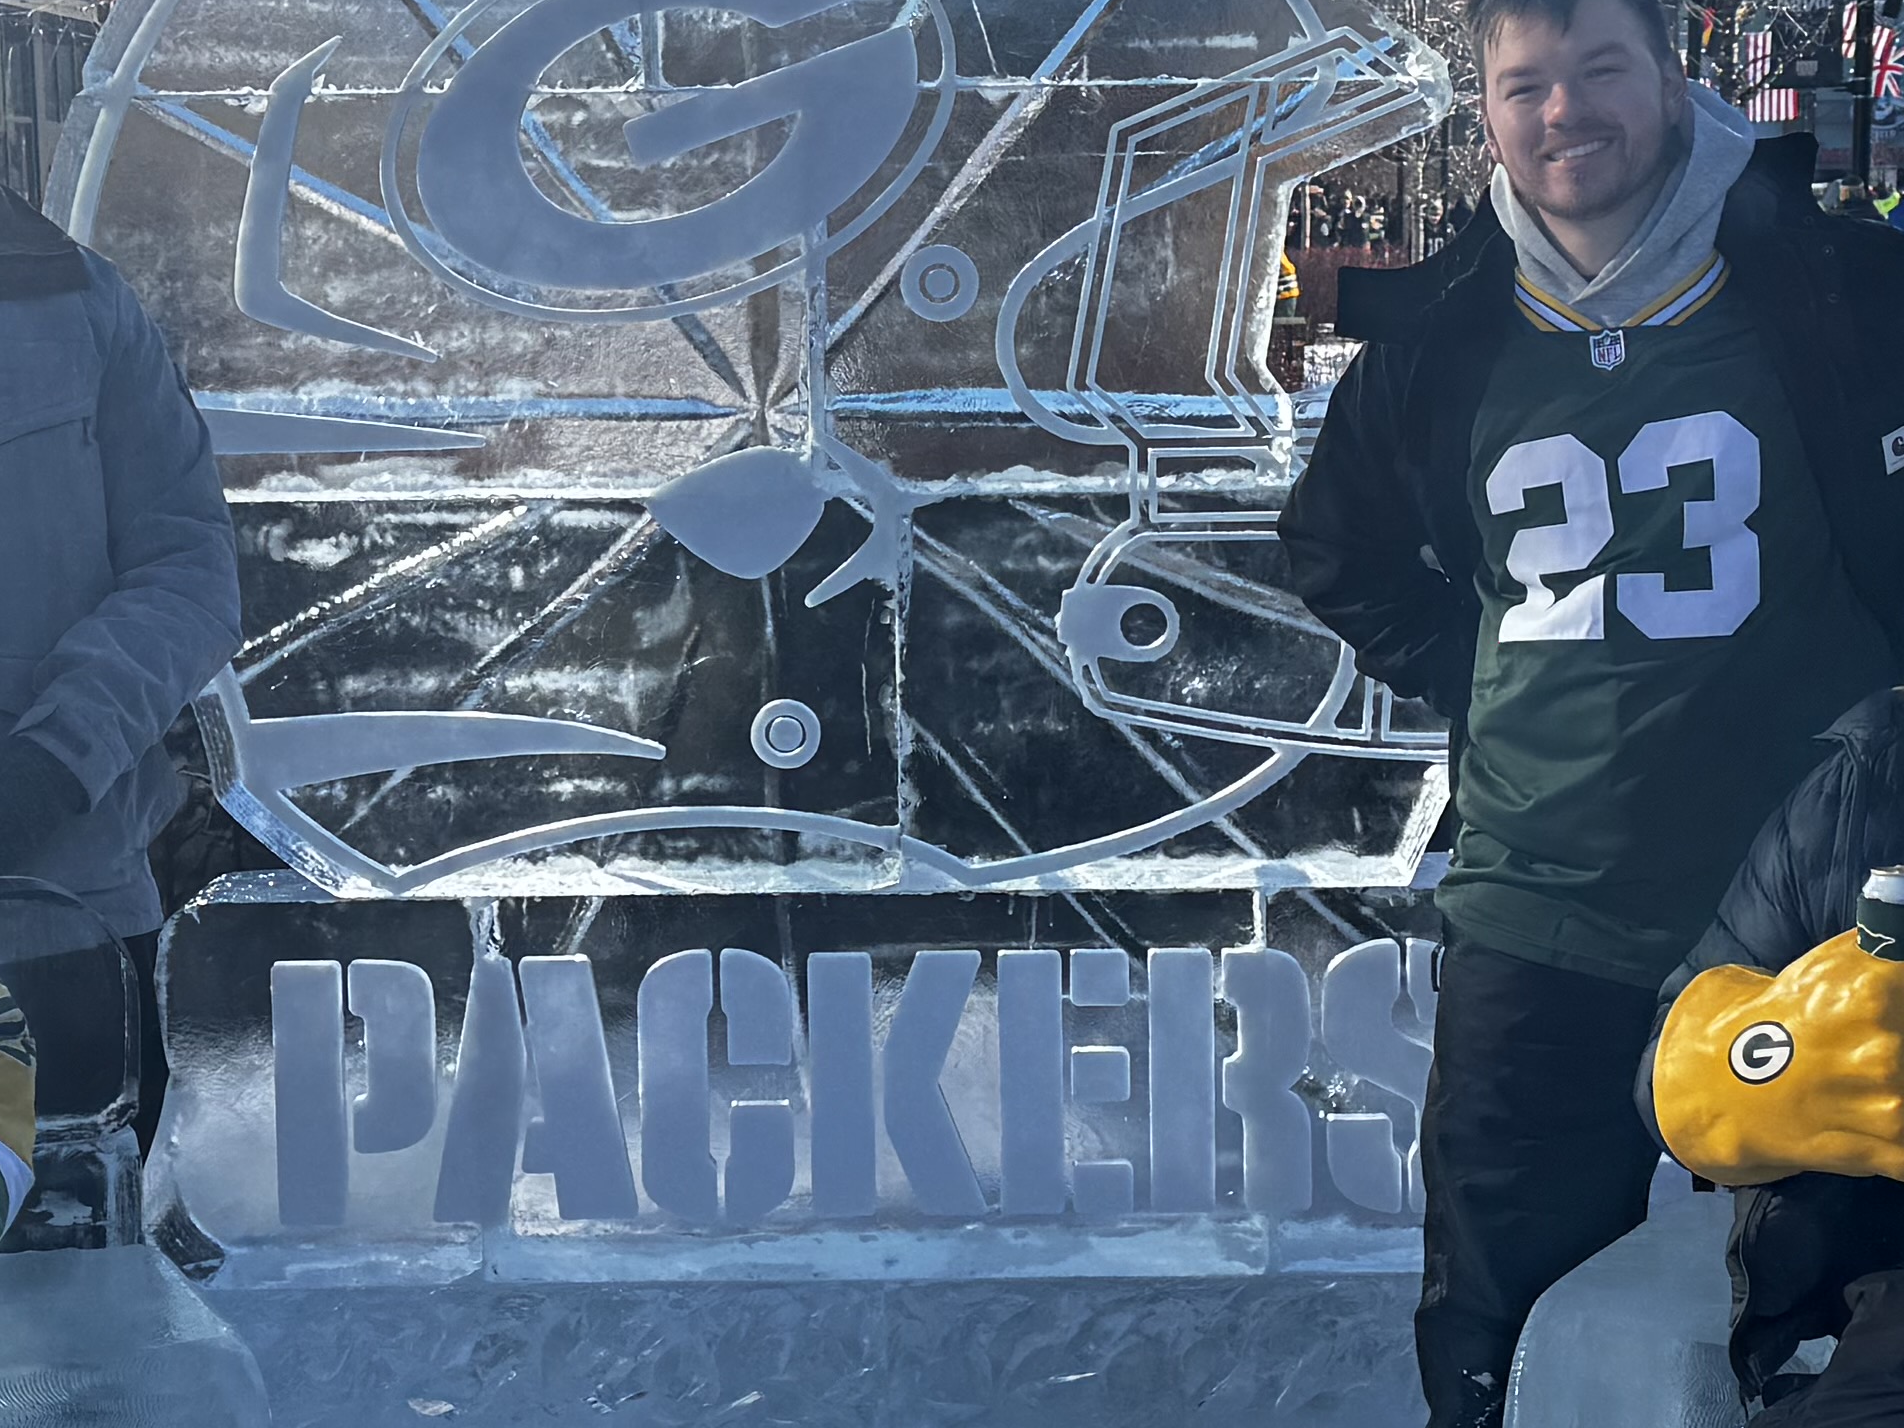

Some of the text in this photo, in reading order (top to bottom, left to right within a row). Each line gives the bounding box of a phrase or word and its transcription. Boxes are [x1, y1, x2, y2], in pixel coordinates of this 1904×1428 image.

[1598, 345, 1621, 363] NFL
[1486, 411, 1760, 642] 23
[271, 938, 1441, 1228] PACKERS
[1731, 1024, 1790, 1080] G
